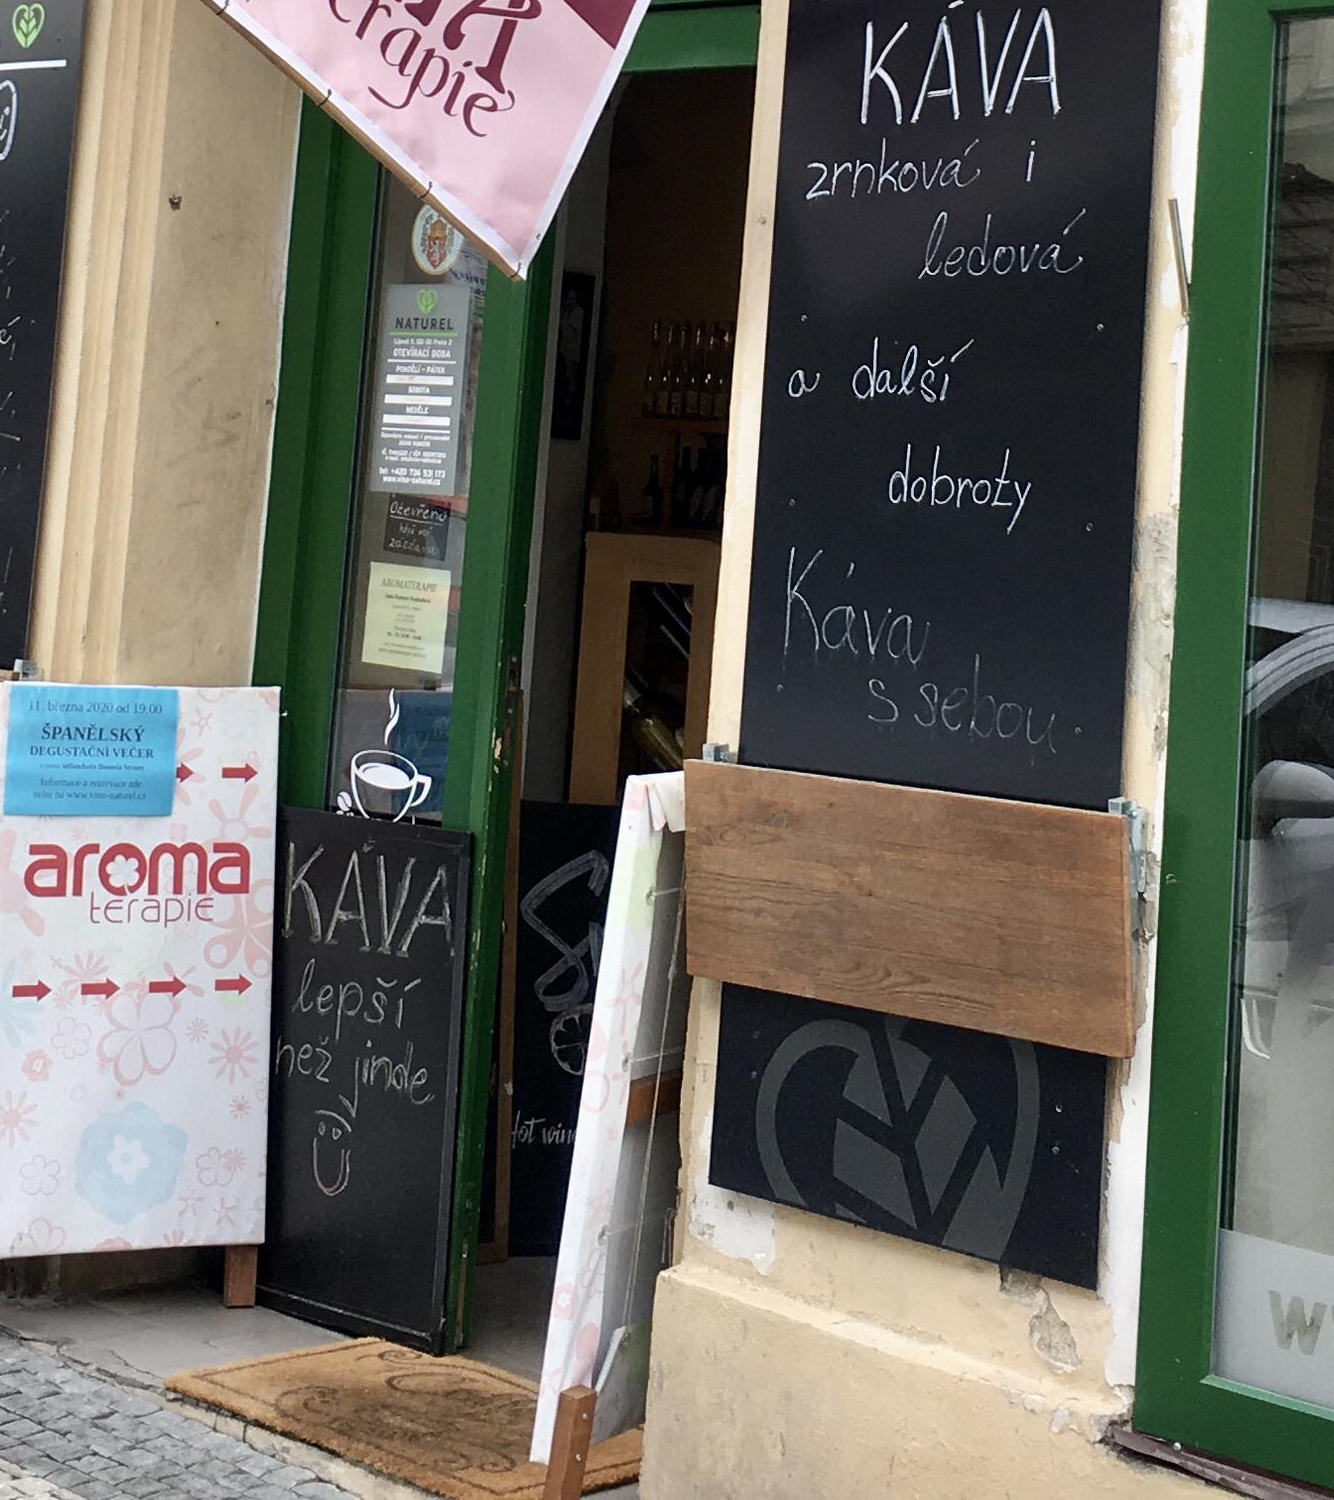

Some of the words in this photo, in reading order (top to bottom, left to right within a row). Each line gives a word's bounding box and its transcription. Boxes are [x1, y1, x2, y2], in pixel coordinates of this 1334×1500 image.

[806, 138, 982, 200] zrnková
[1025, 140, 1037, 182] i
[919, 208, 1087, 280] ledová
[395, 317, 454, 330] NATUREL
[788, 370, 821, 398] a
[852, 337, 975, 402] další
[889, 443, 1032, 535] dobroty
[783, 546, 931, 665] Káva
[47, 700, 84, 712] března
[86, 700, 113, 713] 2020
[115, 702, 131, 714] od
[133, 703, 163, 715] 19:00
[867, 678, 899, 724] s
[41, 722, 146, 743] ŠPANĚLSKÝ
[112, 748, 155, 759] VEČER
[24, 842, 250, 898] aroma
[282, 839, 456, 958] KÁVA
[90, 891, 214, 929] terapie
[293, 957, 422, 1041] lepší
[274, 1035, 334, 1083] než
[339, 1038, 435, 1120] jinde
